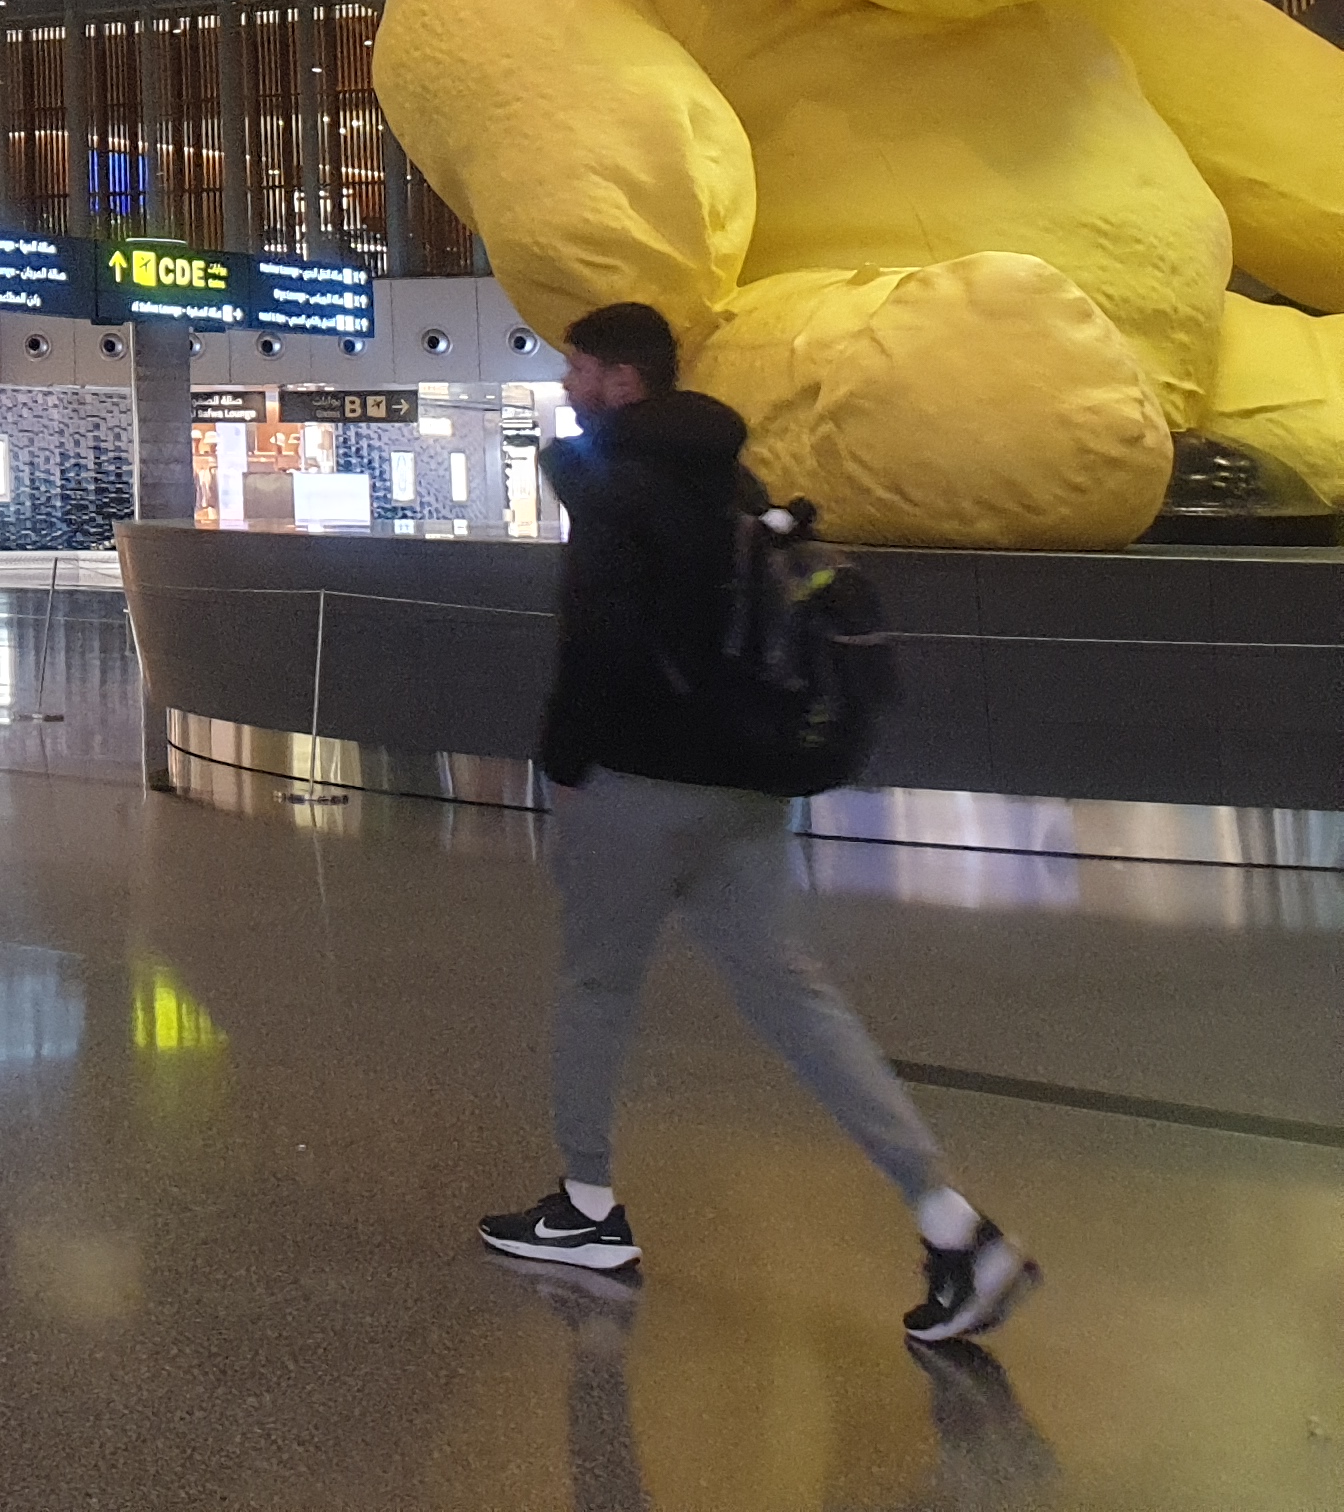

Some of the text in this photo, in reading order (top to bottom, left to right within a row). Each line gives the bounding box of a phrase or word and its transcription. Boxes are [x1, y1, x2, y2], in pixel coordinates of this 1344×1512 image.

[158, 256, 207, 288] CDE
[224, 408, 257, 421] Lounge
[344, 395, 362, 418] B
